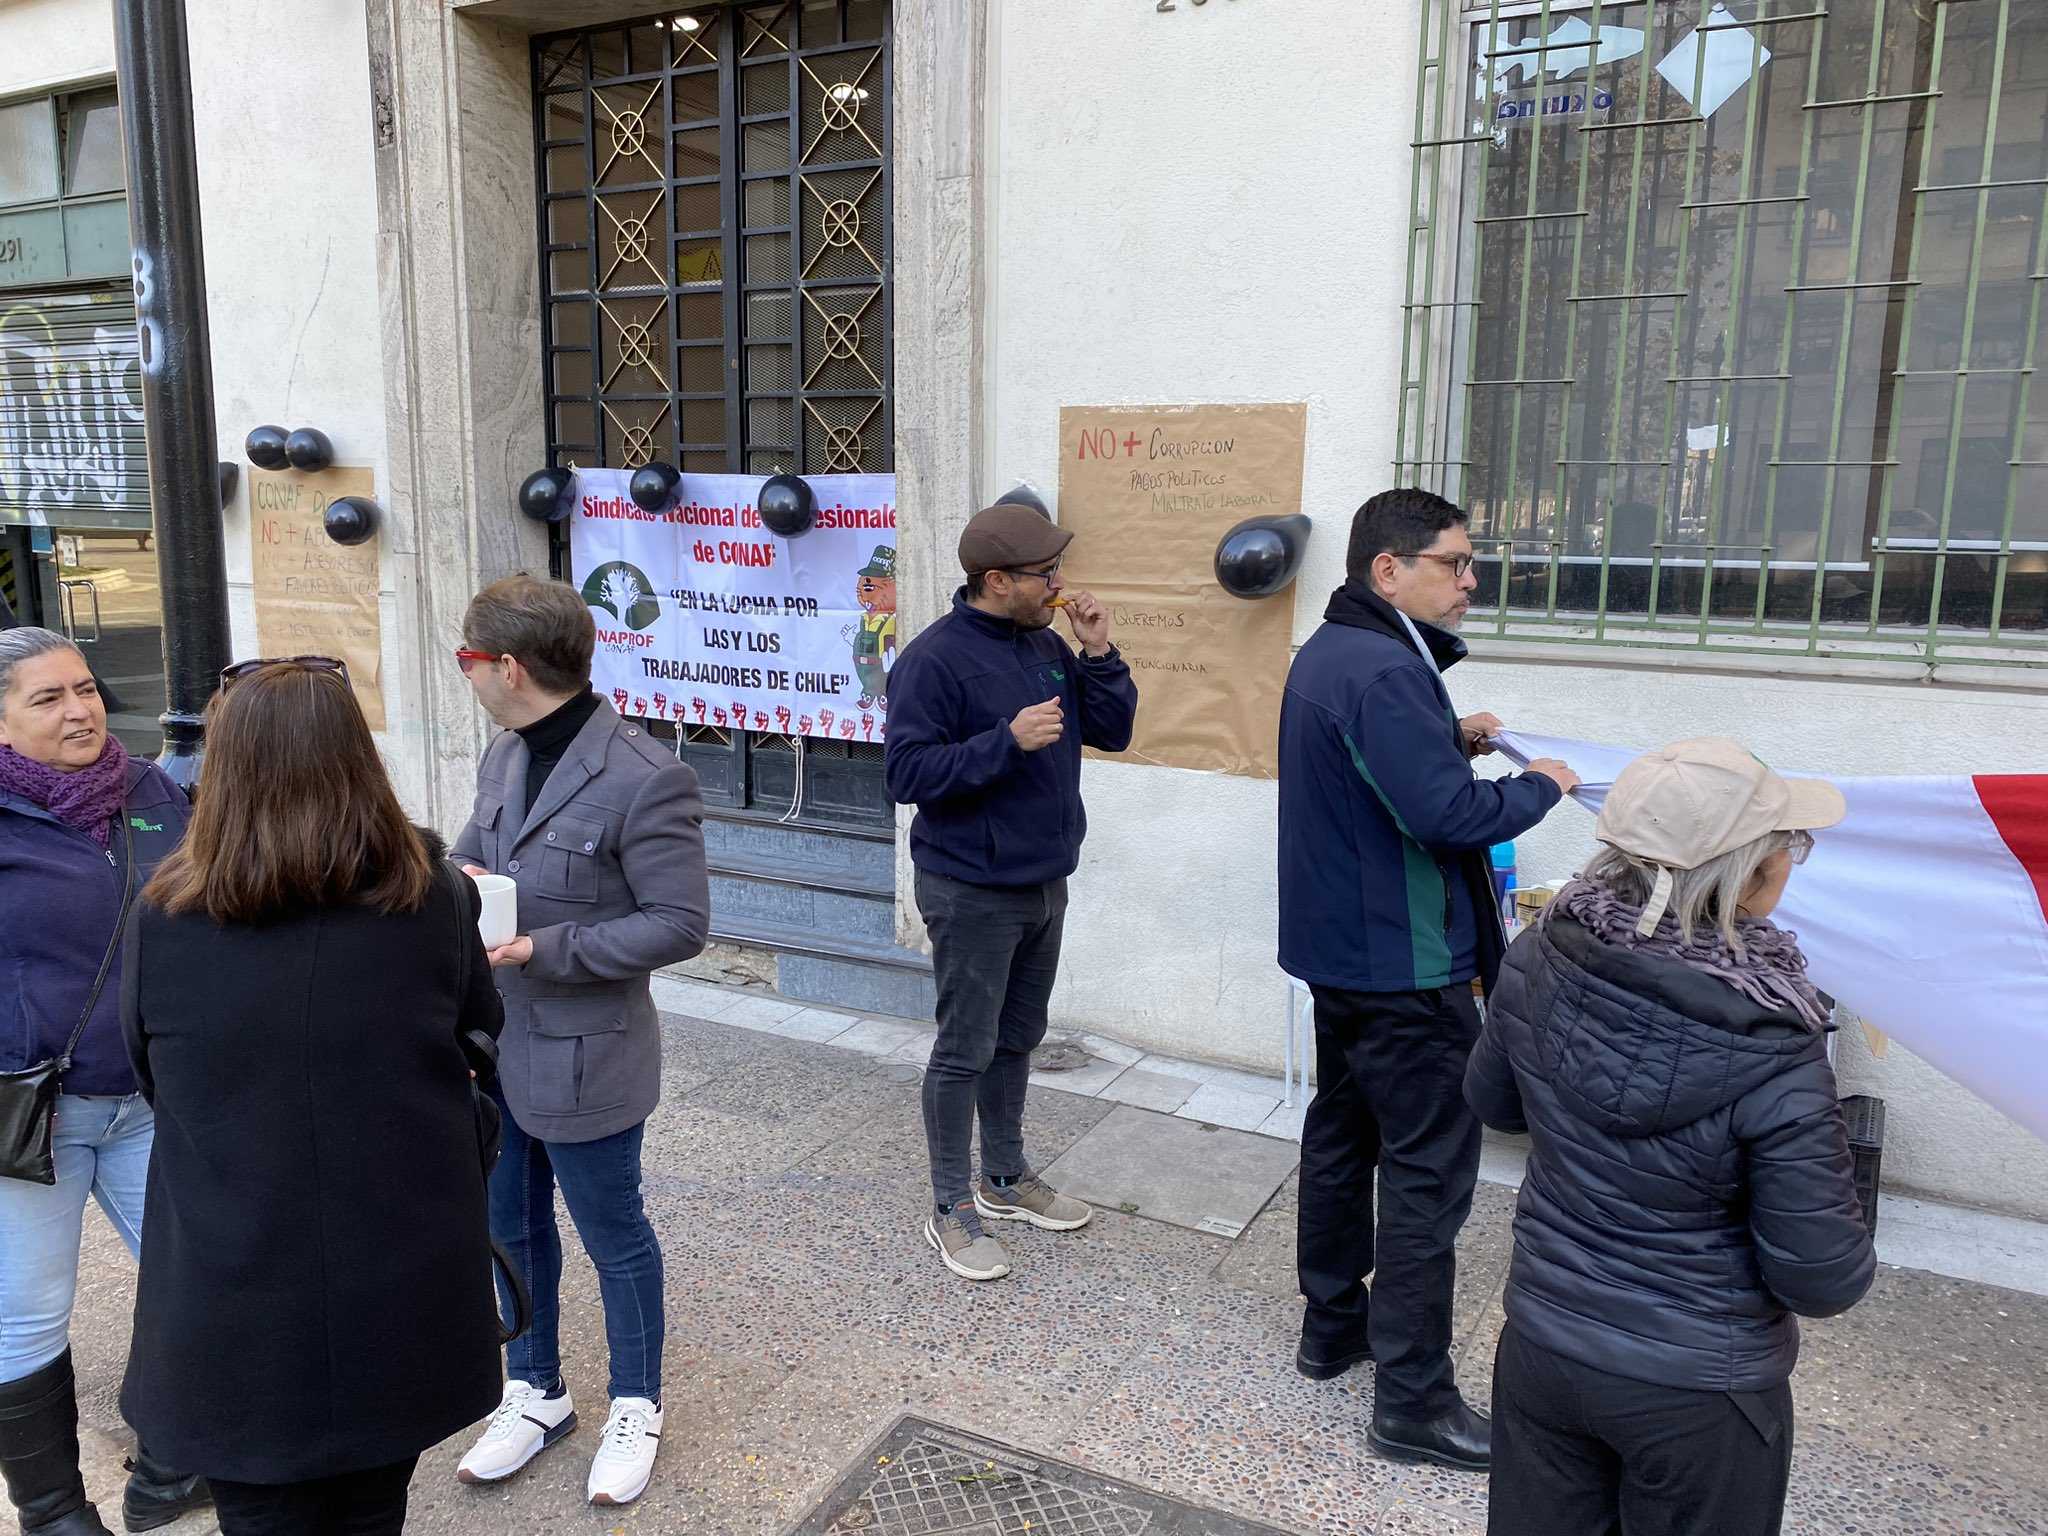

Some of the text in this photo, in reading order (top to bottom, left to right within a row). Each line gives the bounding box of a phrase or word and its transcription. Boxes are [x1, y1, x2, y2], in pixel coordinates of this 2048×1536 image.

[1078, 427, 1116, 460] NO
[257, 481, 305, 511] CONAF
[693, 539, 776, 567] de CONAF
[701, 591, 719, 612] LA
[721, 593, 779, 616] LUCHA
[784, 596, 819, 618] POR
[1113, 605, 1185, 627] QUEREMOS
[747, 631, 781, 654] LOS
[642, 656, 762, 689] TRABAJADORES
[767, 669, 790, 691] DE
